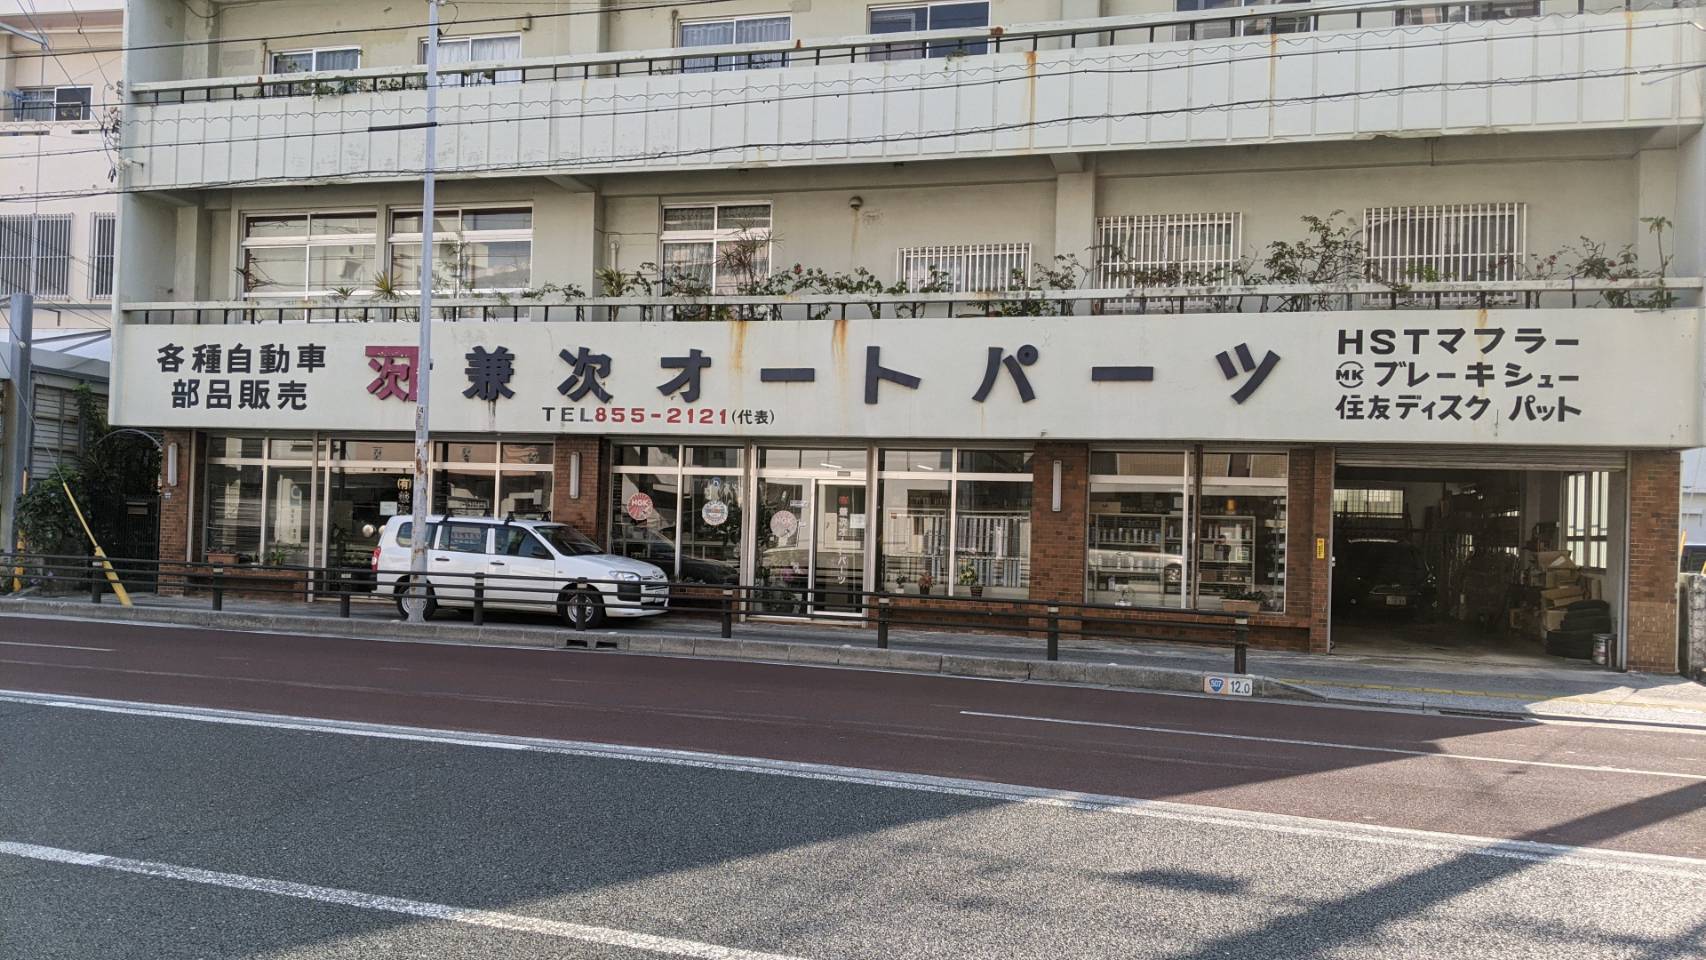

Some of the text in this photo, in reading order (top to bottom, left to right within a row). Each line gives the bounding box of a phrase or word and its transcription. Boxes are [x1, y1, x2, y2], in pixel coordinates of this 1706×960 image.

[1337, 328, 1580, 355] HSTマフラー
[157, 343, 327, 374] 各種自動車
[463, 343, 1281, 404] 兼次オートパーツ
[1374, 361, 1580, 389] ブレーキシュー
[172, 379, 308, 410] 部品販売
[1335, 395, 1582, 423] 住友ディスク パット
[1231, 680, 1250, 694] 12.0
